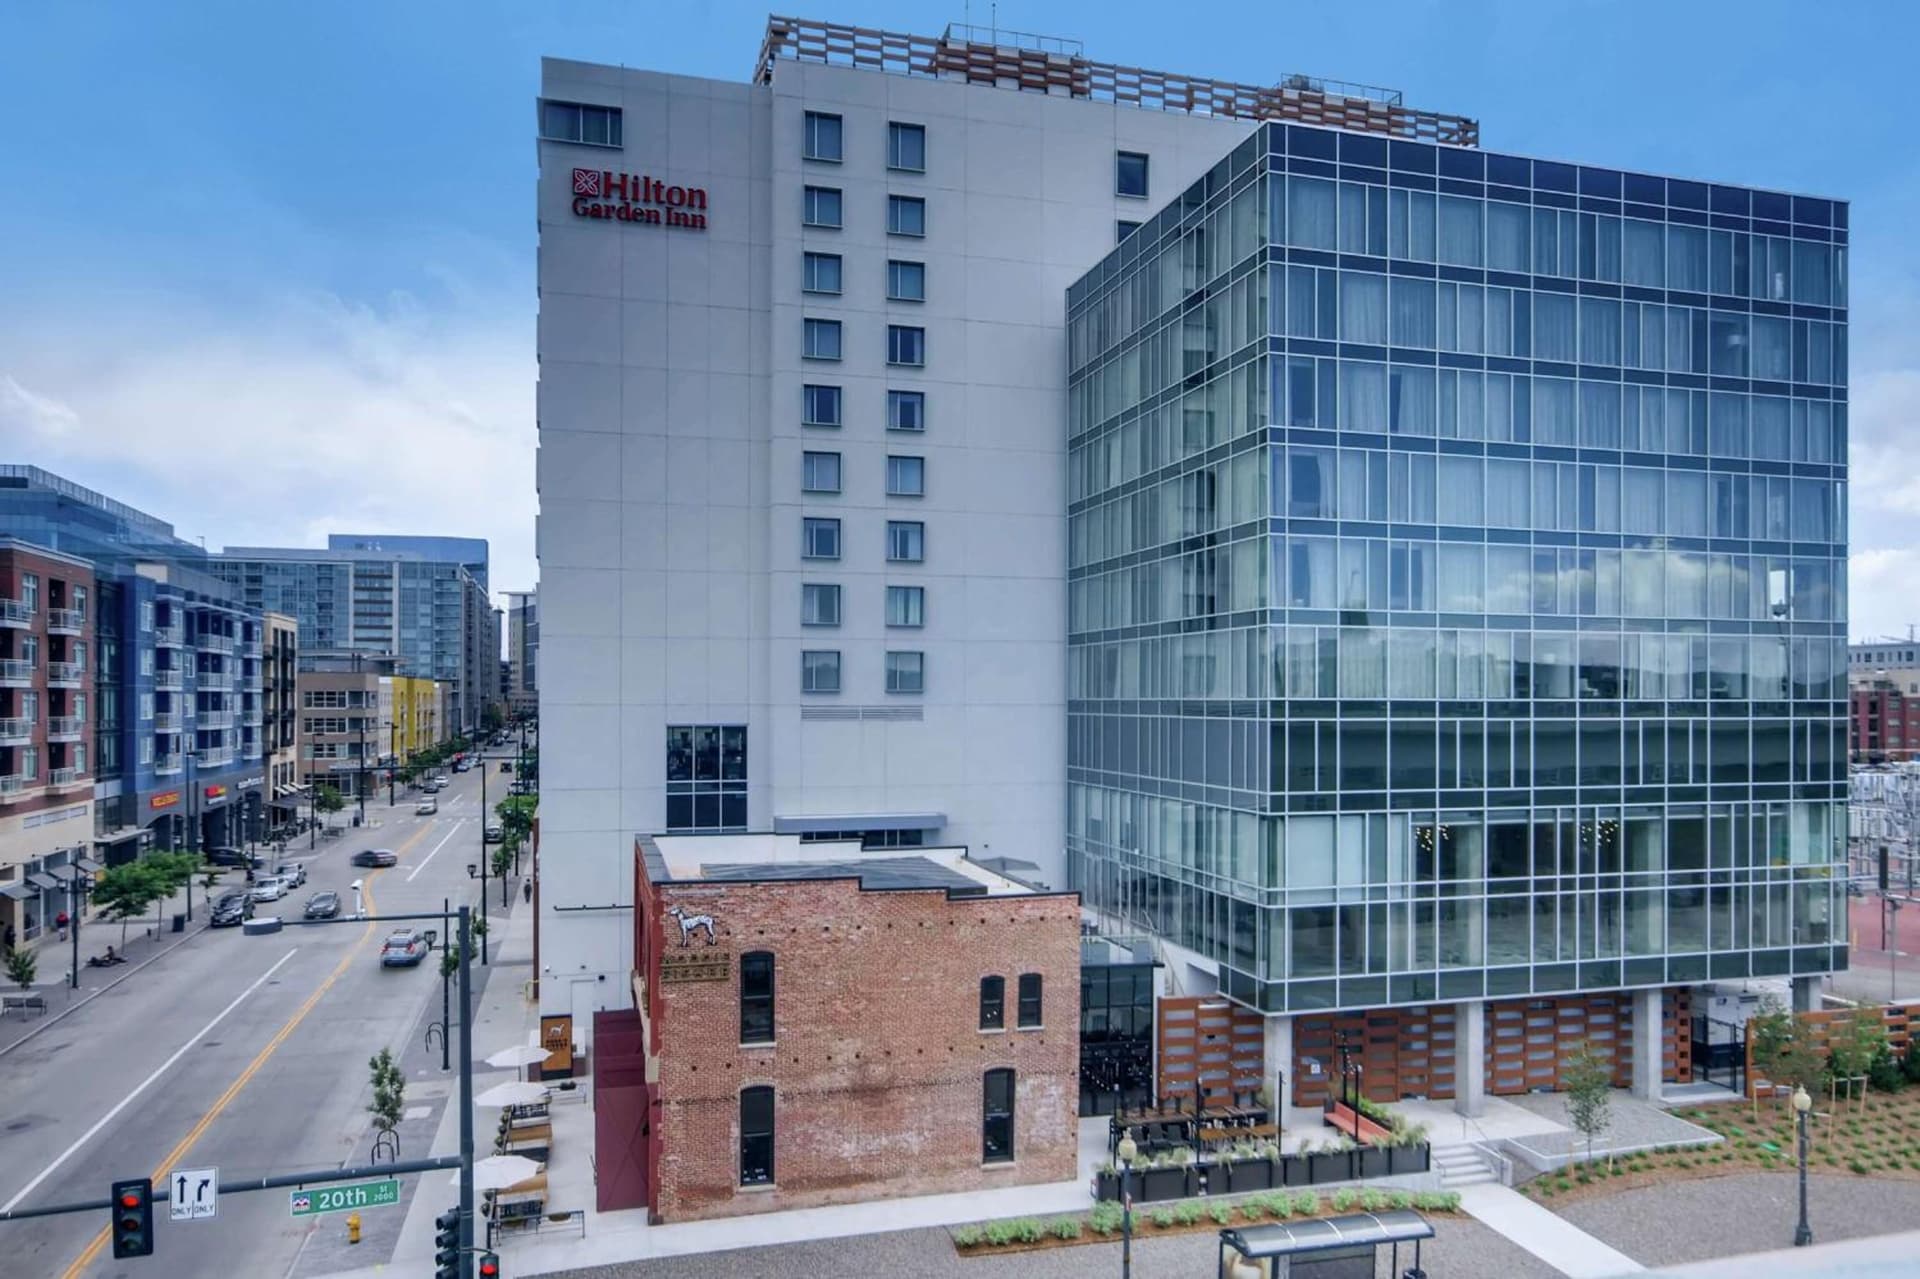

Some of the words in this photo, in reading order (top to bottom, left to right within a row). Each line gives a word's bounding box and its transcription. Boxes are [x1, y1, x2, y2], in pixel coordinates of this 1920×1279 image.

[602, 171, 707, 209] Hilton
[572, 197, 661, 225] Garden
[664, 206, 707, 229] Inn
[319, 1187, 366, 1209] 20th
[171, 1207, 191, 1217] ONLY
[194, 1204, 214, 1215] ONLY
